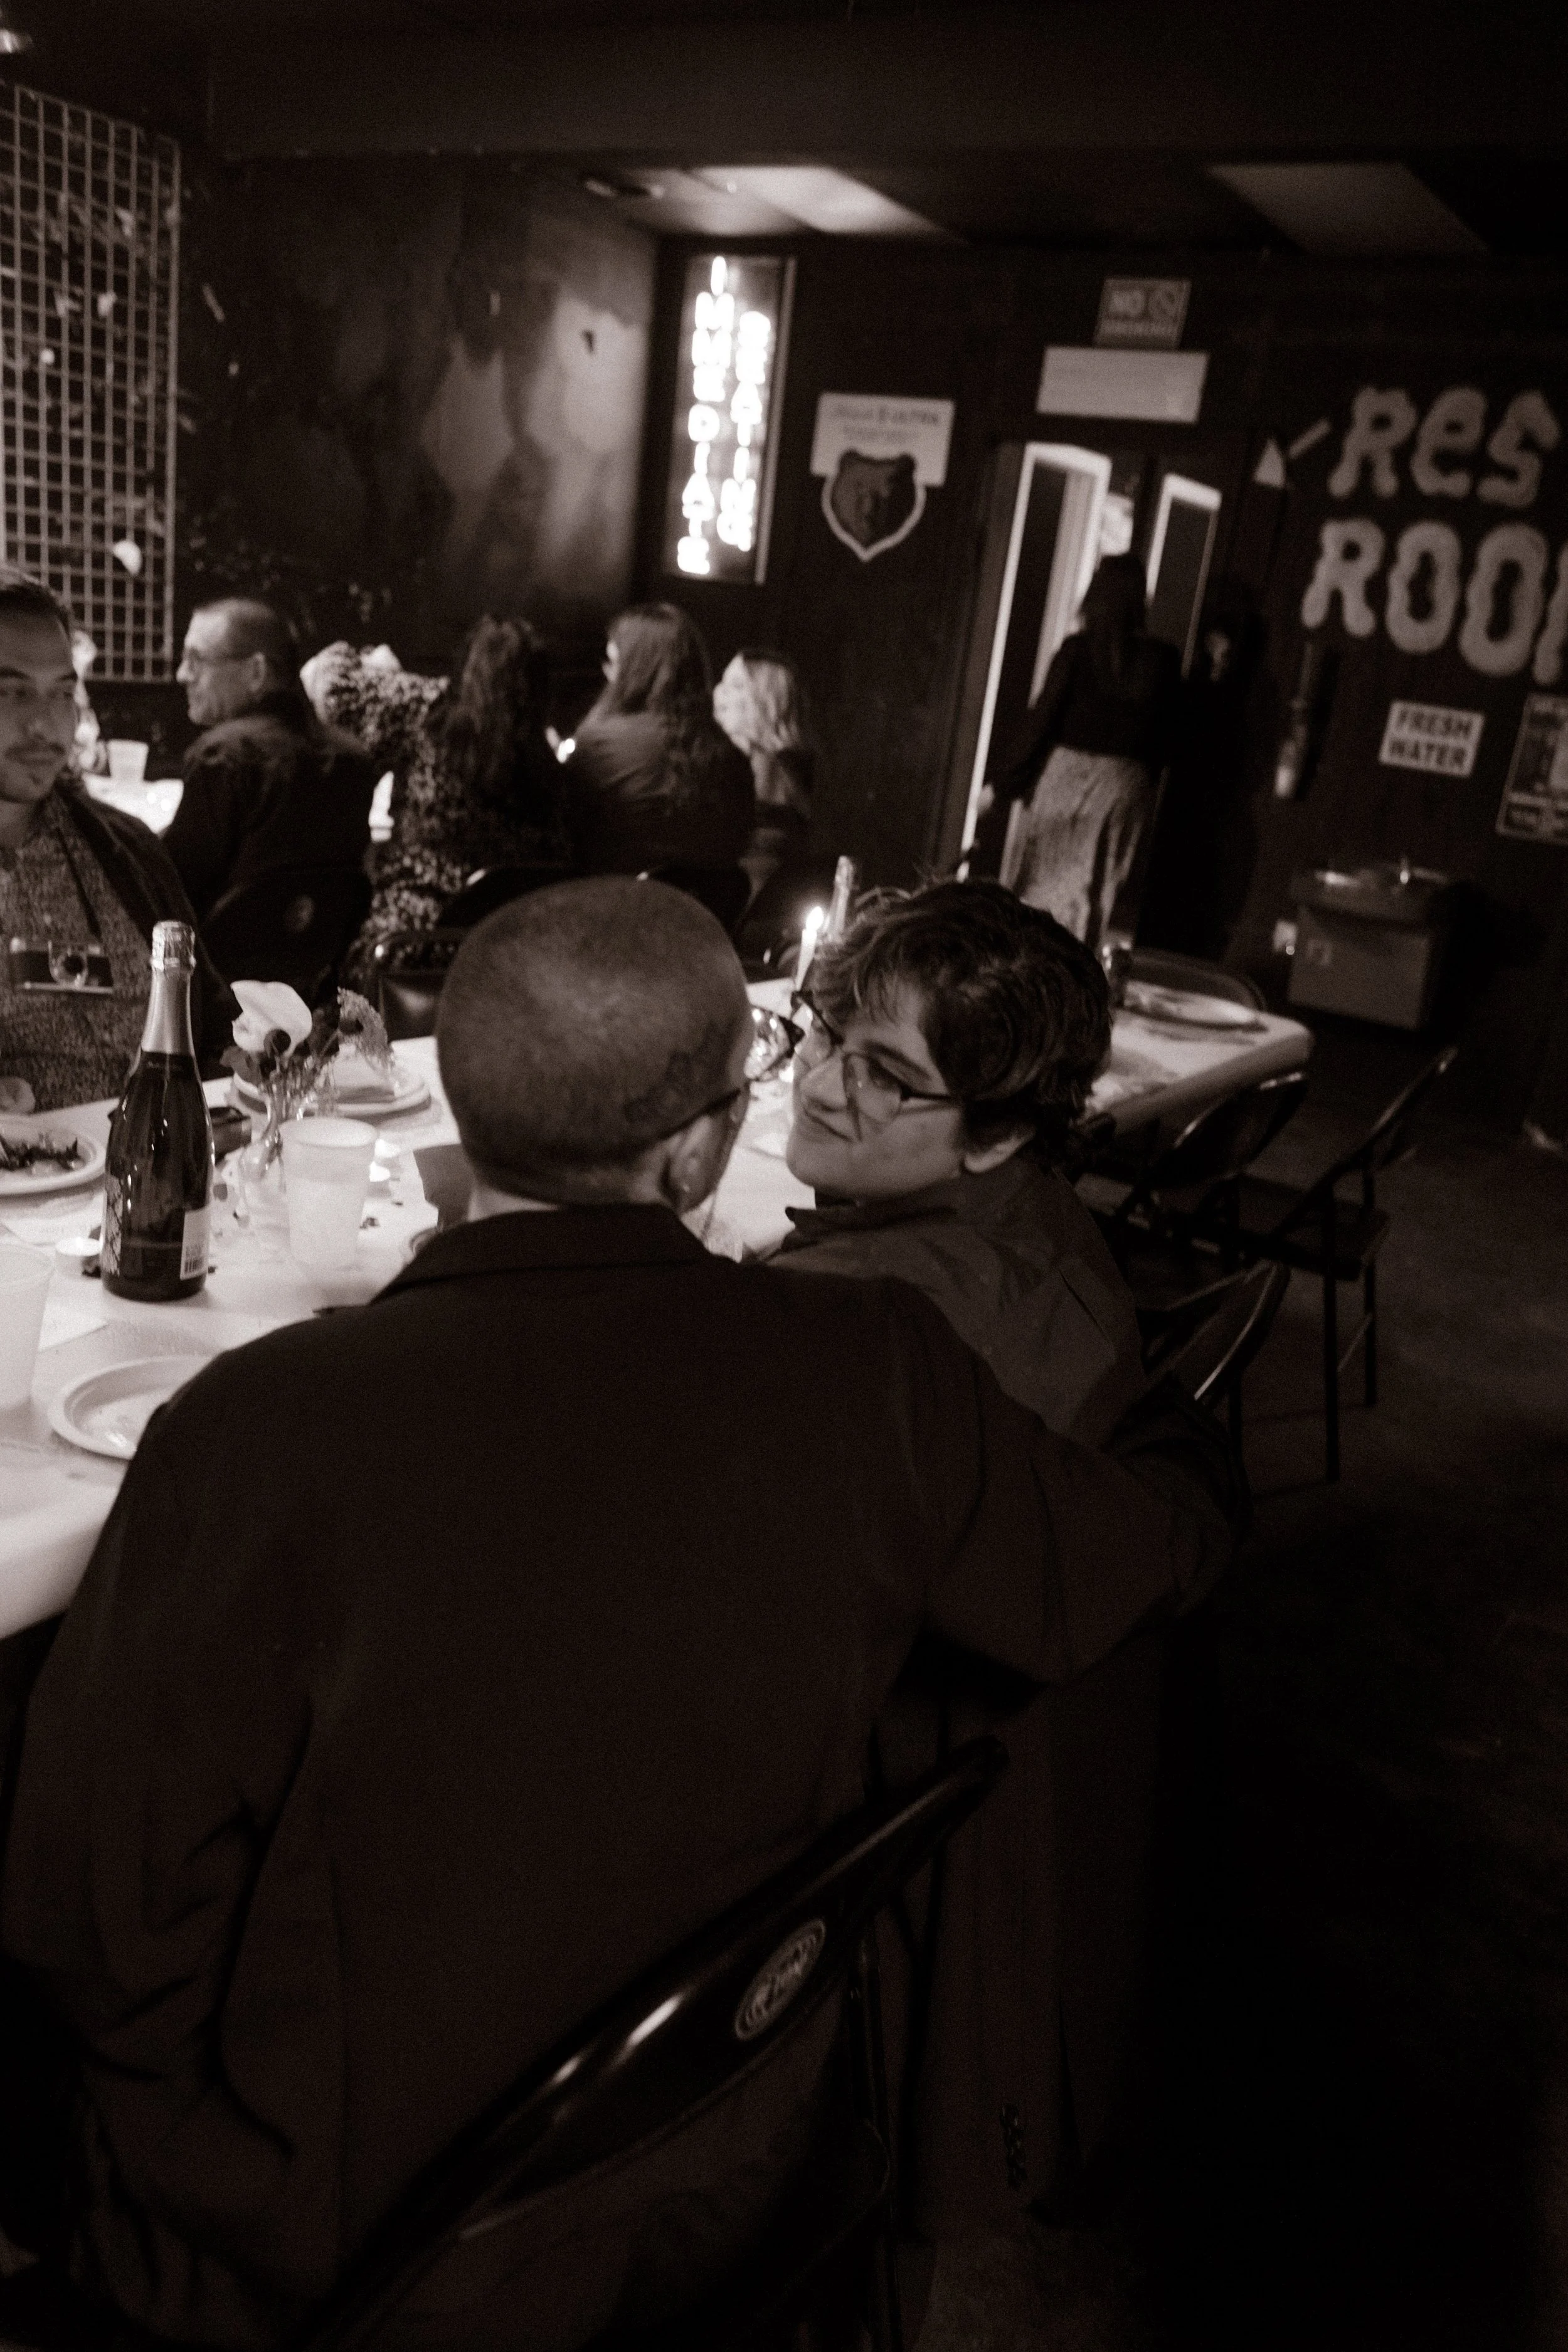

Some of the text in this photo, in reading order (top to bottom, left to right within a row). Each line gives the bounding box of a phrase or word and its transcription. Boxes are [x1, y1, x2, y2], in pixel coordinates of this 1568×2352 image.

[677, 255, 735, 575] IMMEDIATE
[716, 310, 771, 552] SEATING
[1389, 739, 1466, 769] WATER
[1395, 708, 1473, 739] FRESH
